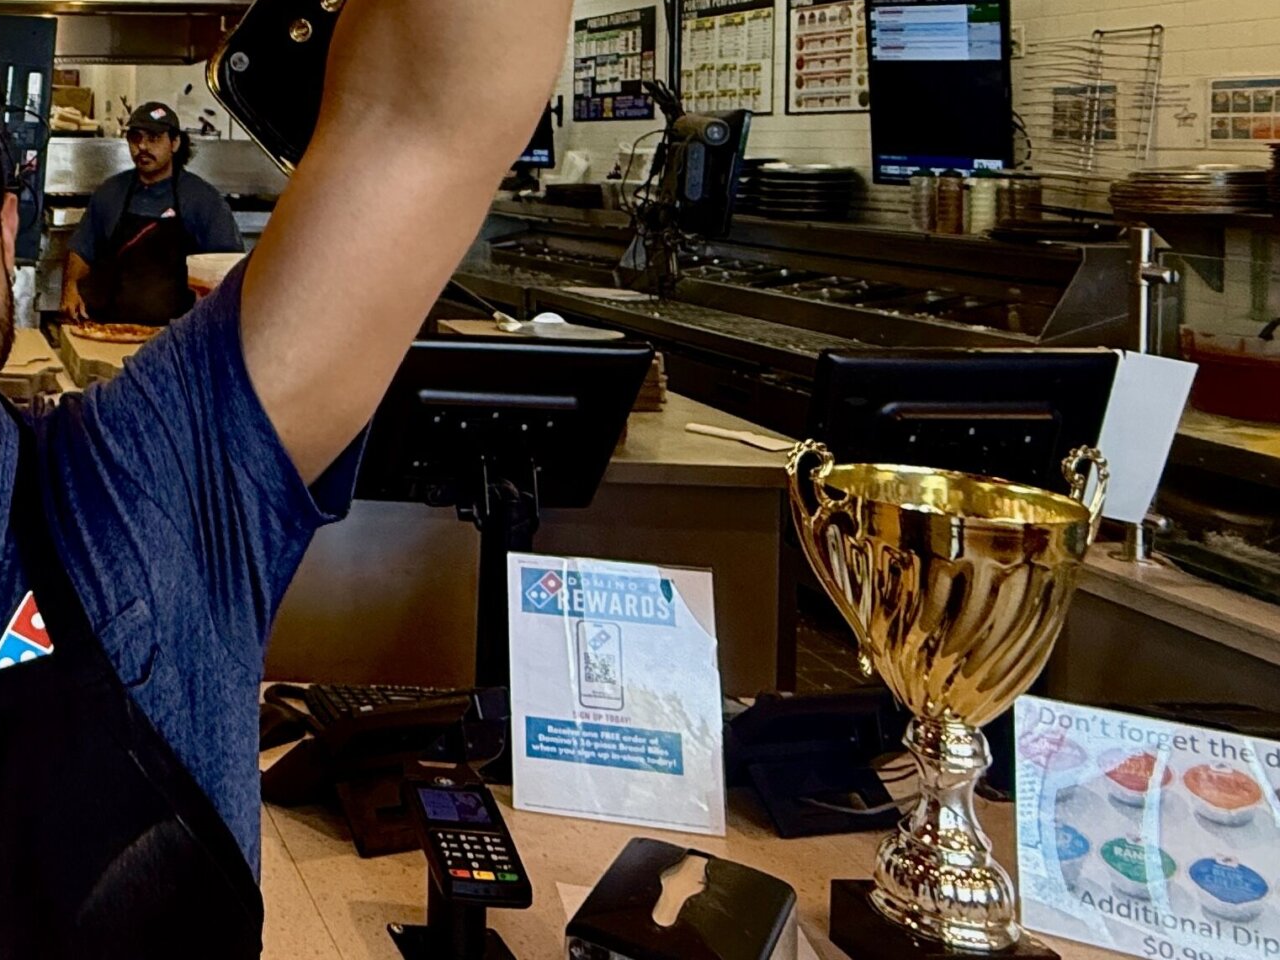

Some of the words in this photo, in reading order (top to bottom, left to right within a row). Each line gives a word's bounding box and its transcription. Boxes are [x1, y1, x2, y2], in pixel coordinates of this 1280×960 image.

[557, 588, 671, 621] REWARDS
[1038, 706, 1111, 738] Don't
[1118, 721, 1201, 753] forget
[1207, 739, 1255, 764] the
[1080, 890, 1221, 940] Additional
